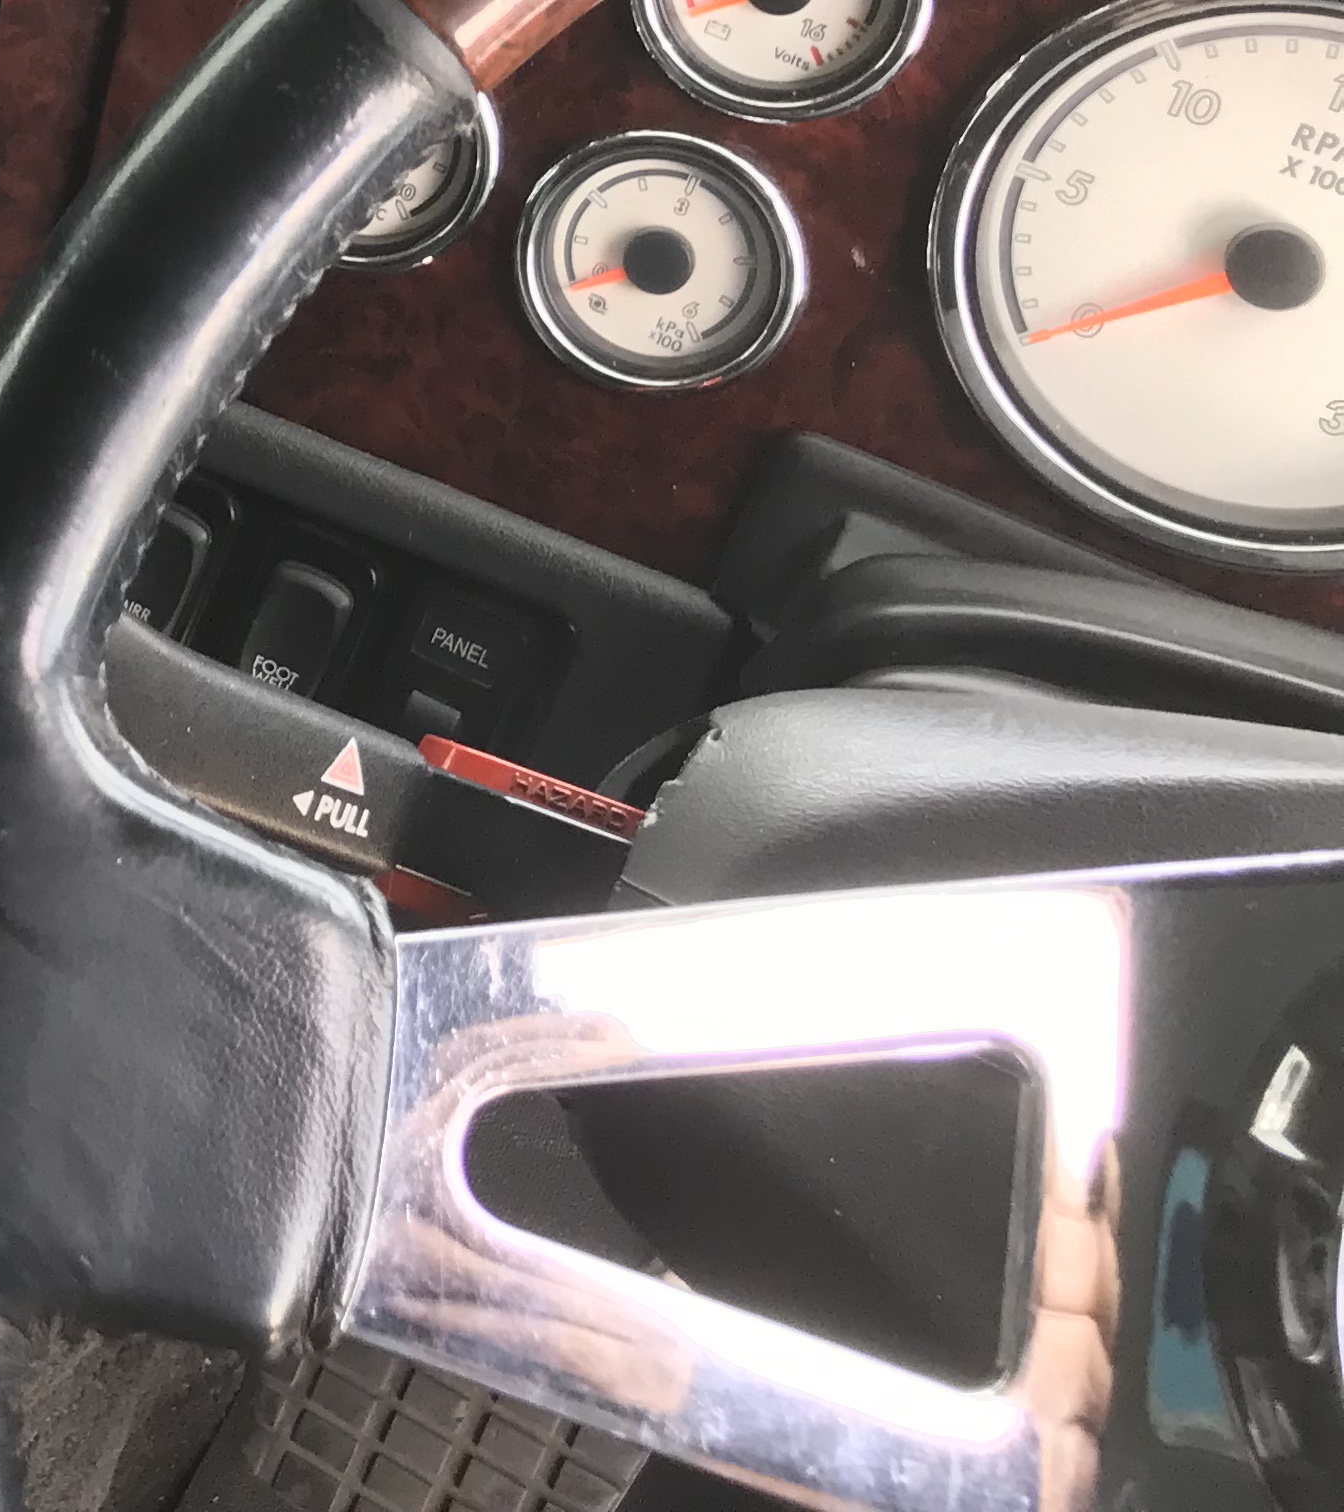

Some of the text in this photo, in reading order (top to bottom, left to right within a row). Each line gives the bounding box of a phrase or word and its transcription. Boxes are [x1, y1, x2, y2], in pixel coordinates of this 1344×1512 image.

[799, 18, 827, 41] 16
[774, 46, 811, 71] Volts
[1167, 78, 1222, 127] 10
[1055, 169, 1095, 206] 5
[673, 197, 691, 217] 3
[655, 316, 685, 339] kPa
[430, 626, 490, 670] PANEL
[252, 654, 300, 687] FOOT
[314, 795, 369, 839] PULL
[511, 771, 629, 832] HAZARD
